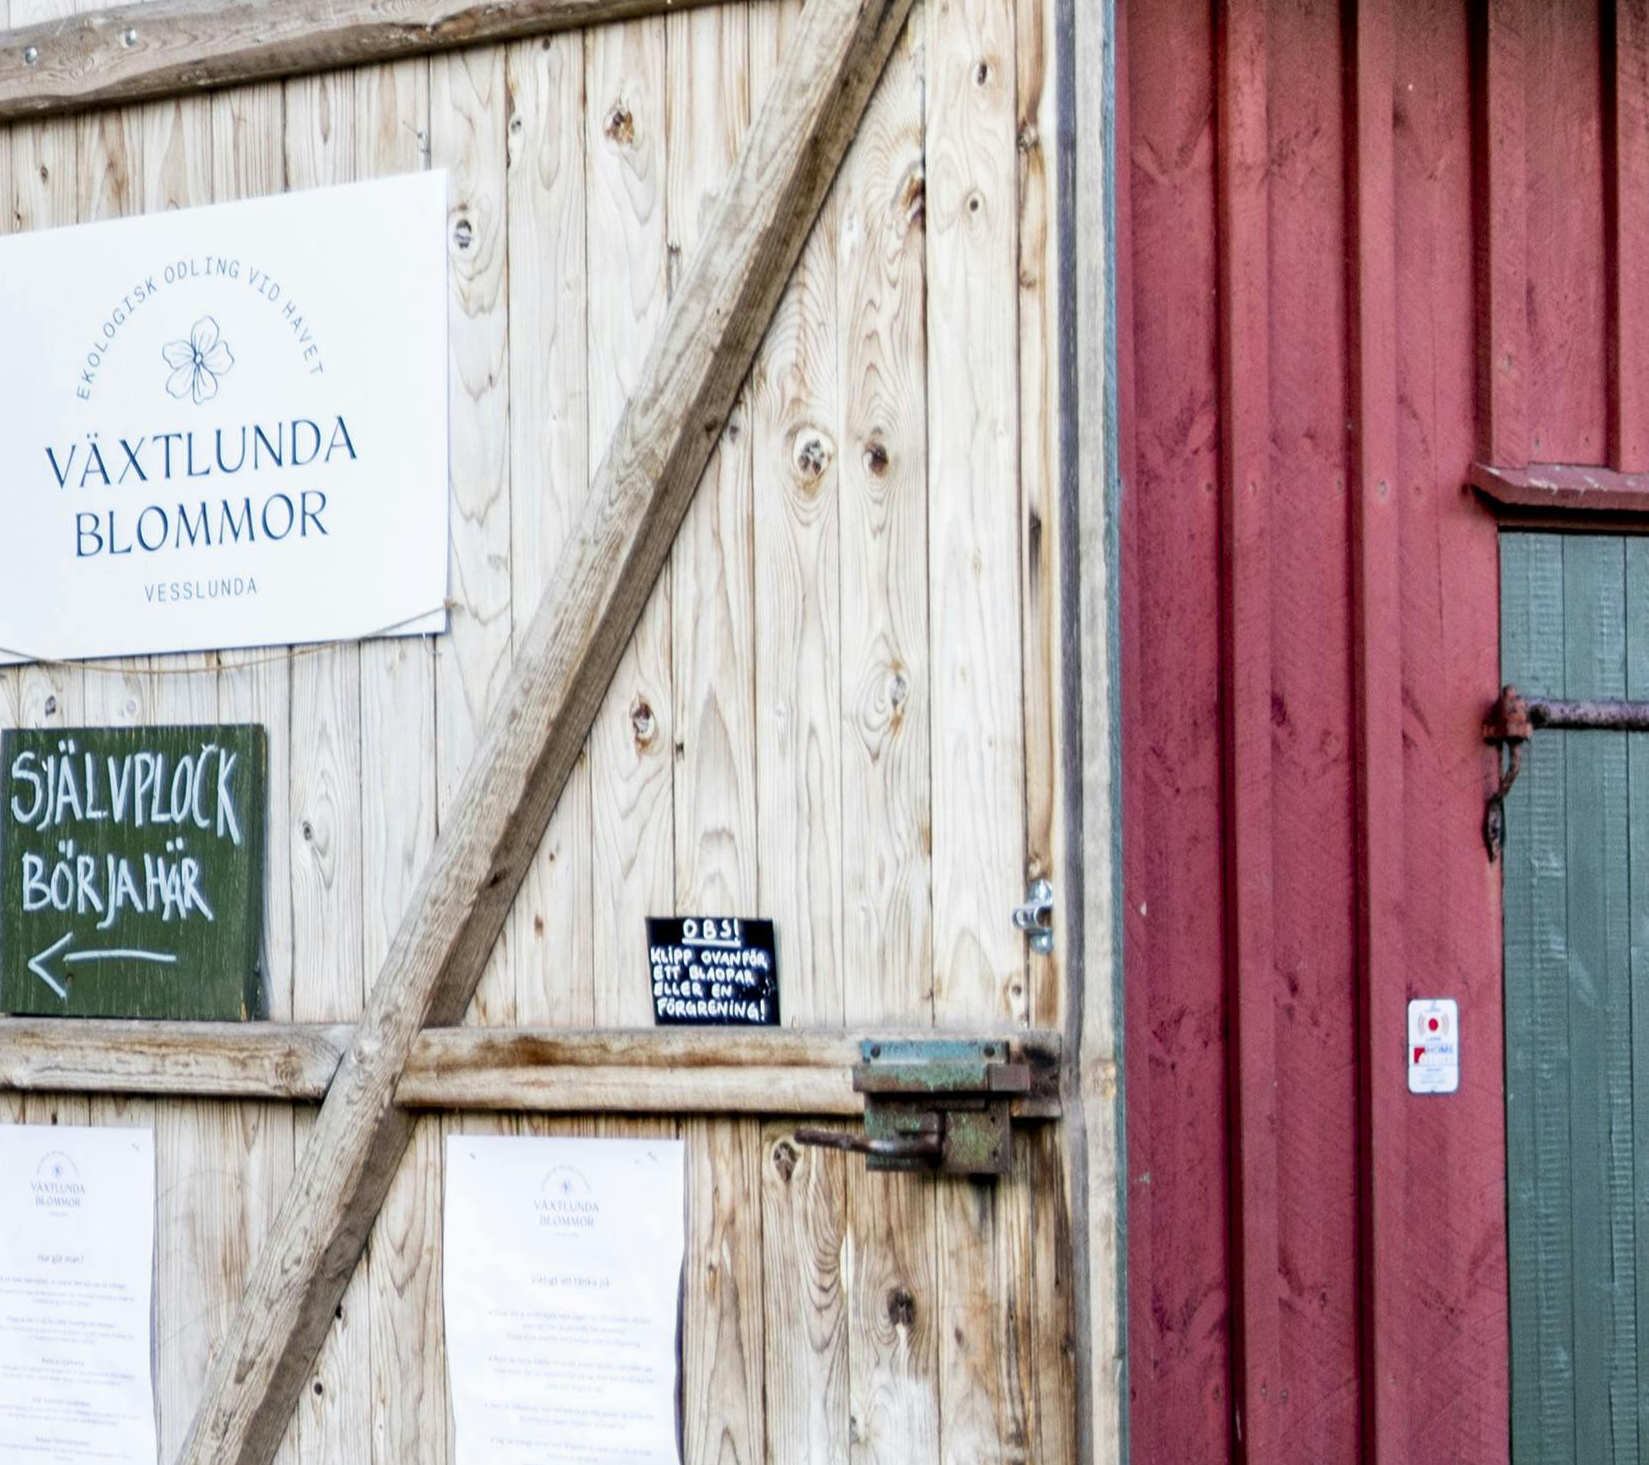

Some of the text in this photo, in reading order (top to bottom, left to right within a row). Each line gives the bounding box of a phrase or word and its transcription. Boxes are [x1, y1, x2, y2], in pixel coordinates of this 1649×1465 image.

[77, 256, 324, 401] EKOLOGISK ODLING VID HAVET
[45, 415, 357, 490] VÄXTLUNDA
[75, 490, 330, 559] BLOMMOR
[145, 577, 259, 603] VESSLUNDA
[10, 738, 241, 847] SJÄLVPLOCK
[22, 836, 215, 931] BÖRJA HÄR
[682, 917, 740, 942] OBS!
[653, 965, 681, 981] ETT
[700, 948, 769, 970] OVANFÖR
[653, 982, 733, 998] ELLER EN
